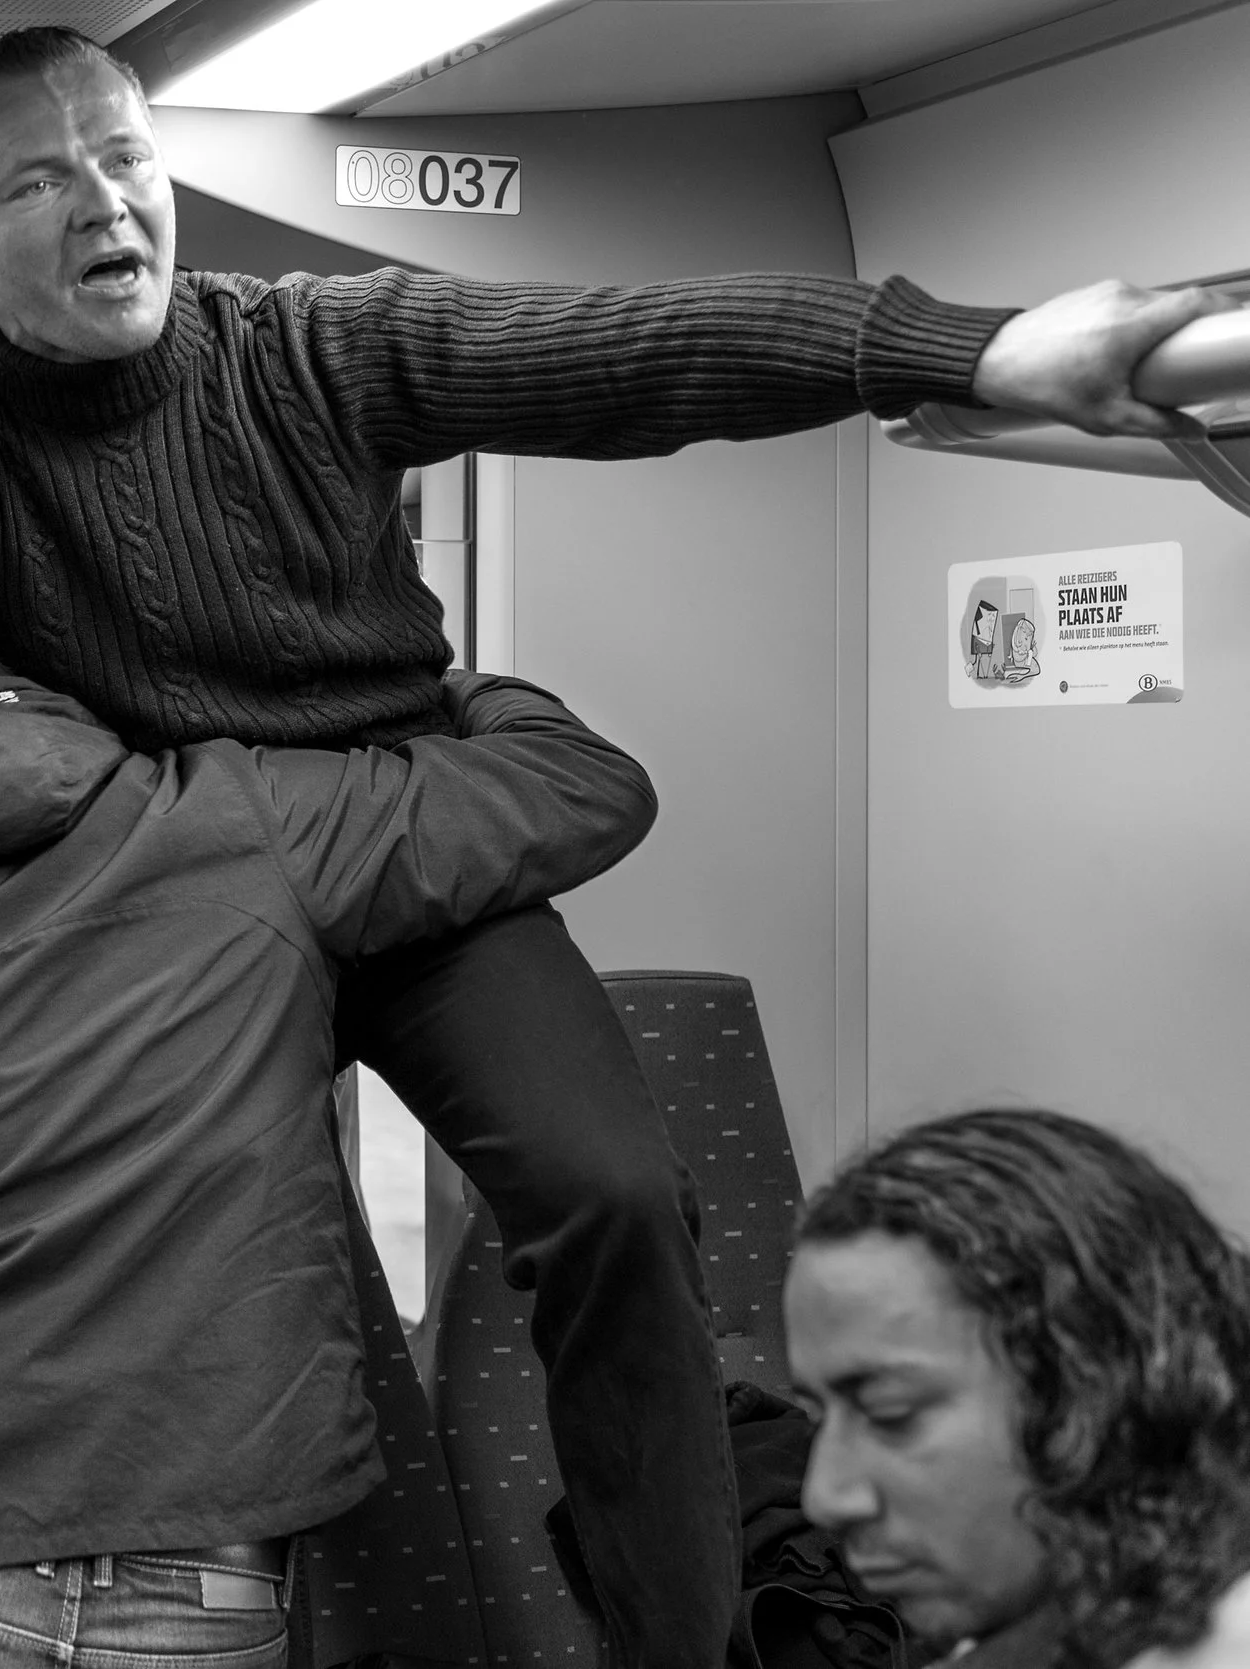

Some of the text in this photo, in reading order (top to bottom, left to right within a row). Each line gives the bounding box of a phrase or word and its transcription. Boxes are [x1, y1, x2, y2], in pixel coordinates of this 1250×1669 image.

[346, 149, 519, 209] 08037
[1058, 571, 1117, 586] ALLE REIZIGERS
[1058, 584, 1127, 606] STAAN HUN
[1058, 605, 1123, 626] PLAATS AF
[1058, 629, 1074, 640] AAN
[1075, 628, 1091, 639] WIE
[1092, 627, 1106, 639] DIE
[1106, 625, 1132, 637] NODIG
